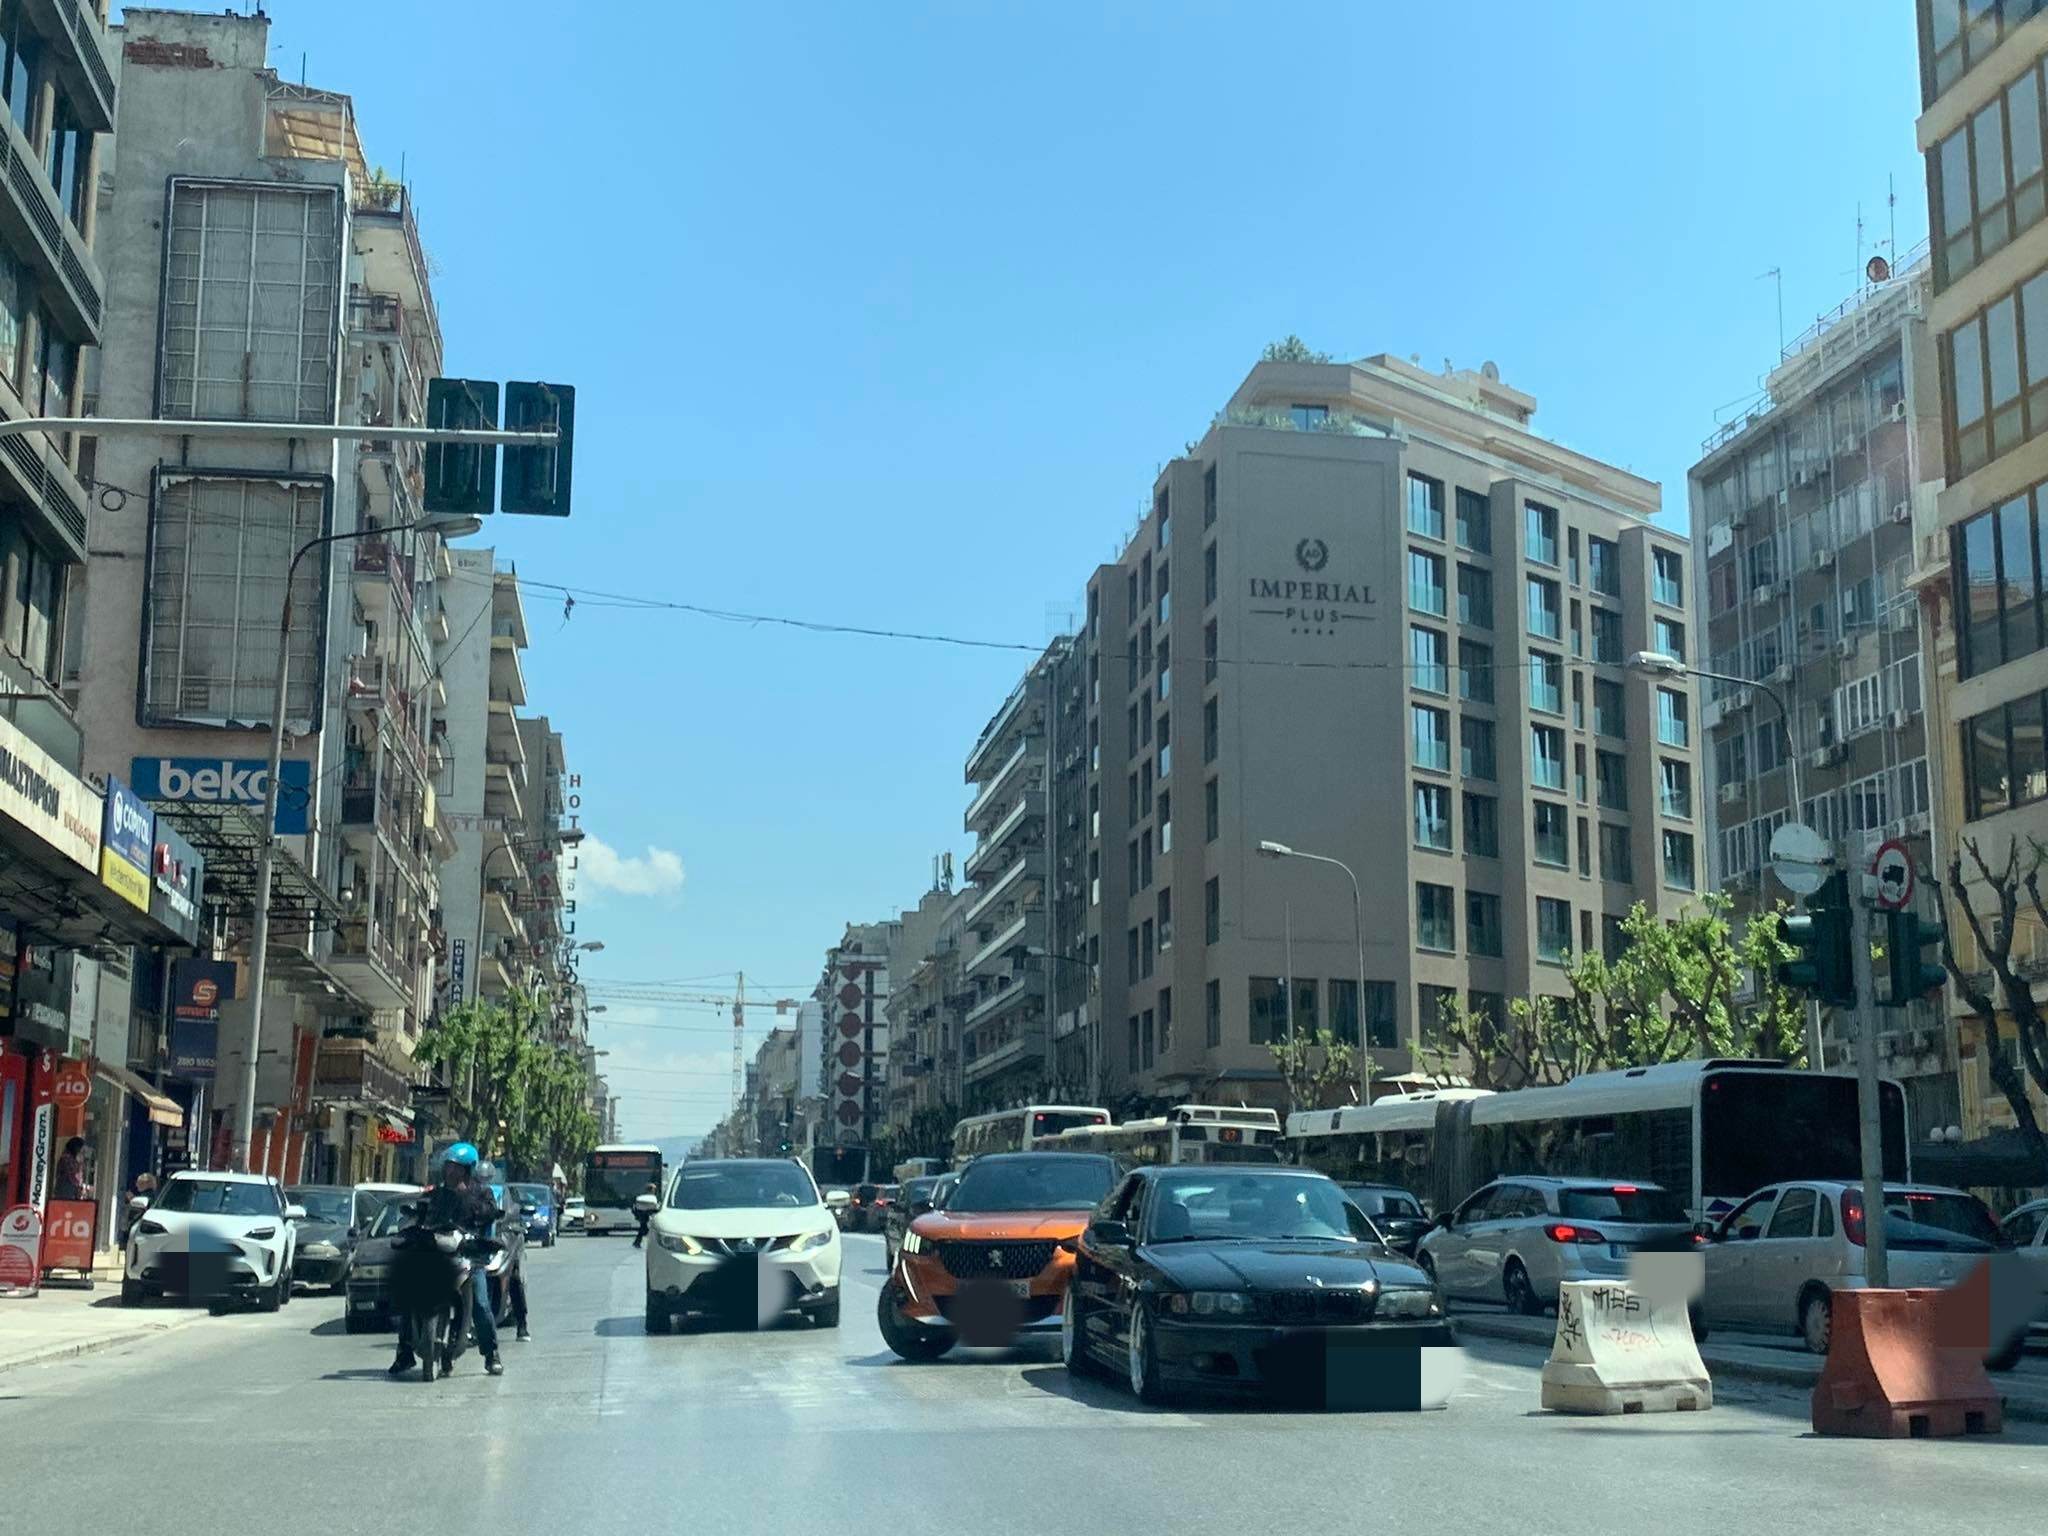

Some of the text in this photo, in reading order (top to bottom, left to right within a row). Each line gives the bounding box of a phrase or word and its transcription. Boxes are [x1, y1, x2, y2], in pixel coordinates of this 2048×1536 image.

[1250, 578, 1376, 604] IMPERIAL
[1286, 607, 1339, 622] PLUS
[159, 760, 269, 800] beko
[56, 1075, 87, 1094] ria
[50, 1211, 90, 1238] ria
